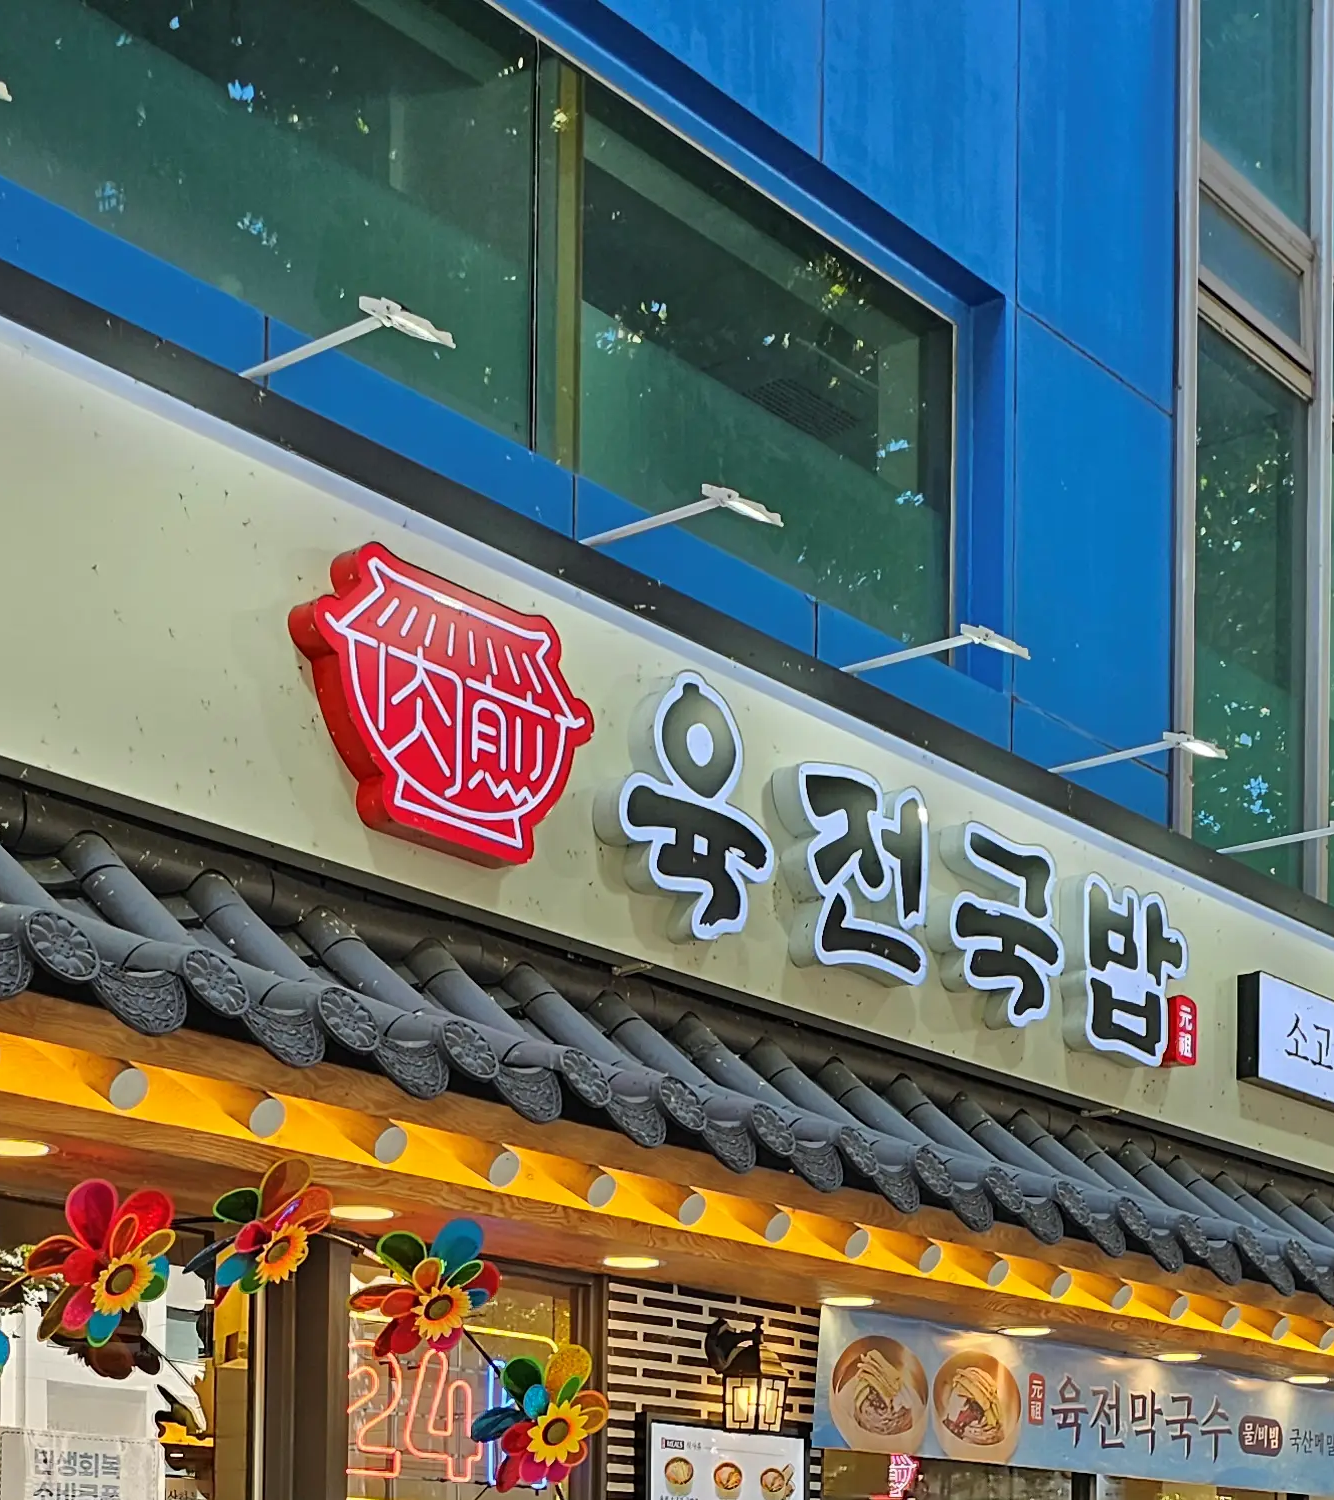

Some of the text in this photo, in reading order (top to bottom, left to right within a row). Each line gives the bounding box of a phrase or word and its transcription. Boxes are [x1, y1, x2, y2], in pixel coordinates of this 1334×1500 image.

[620, 671, 1188, 1067] 육전국밥
[1177, 1004, 1196, 1058] 元祖
[1050, 1373, 1232, 1463] 육전막국수
[1242, 1423, 1279, 1449] 물/비빔
[35, 1448, 120, 1479] 민생회복
